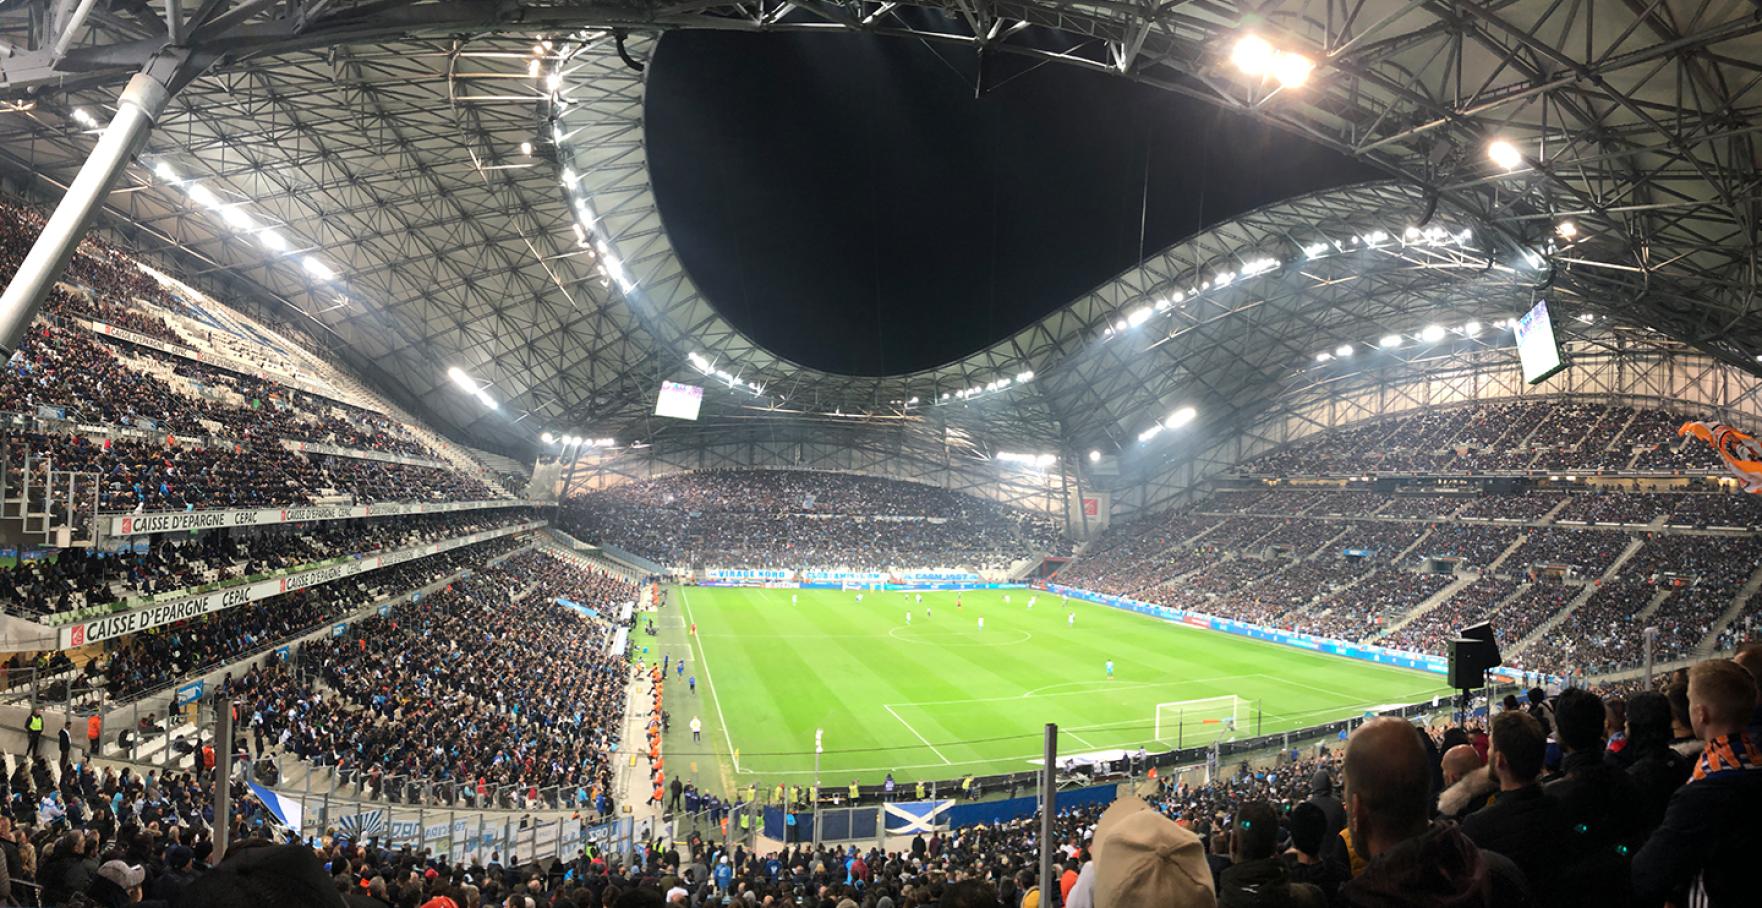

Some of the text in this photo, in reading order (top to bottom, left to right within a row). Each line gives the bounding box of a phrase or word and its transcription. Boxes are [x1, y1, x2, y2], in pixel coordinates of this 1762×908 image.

[133, 516, 169, 532] CAISSE
[172, 513, 225, 529] D'EPARGNE
[234, 511, 257, 524] CEPAC
[719, 568, 755, 578] VIRAGE
[86, 613, 136, 641] CAISSE
[140, 597, 209, 632] D'EPARGNE
[222, 587, 251, 607] CEPAC
